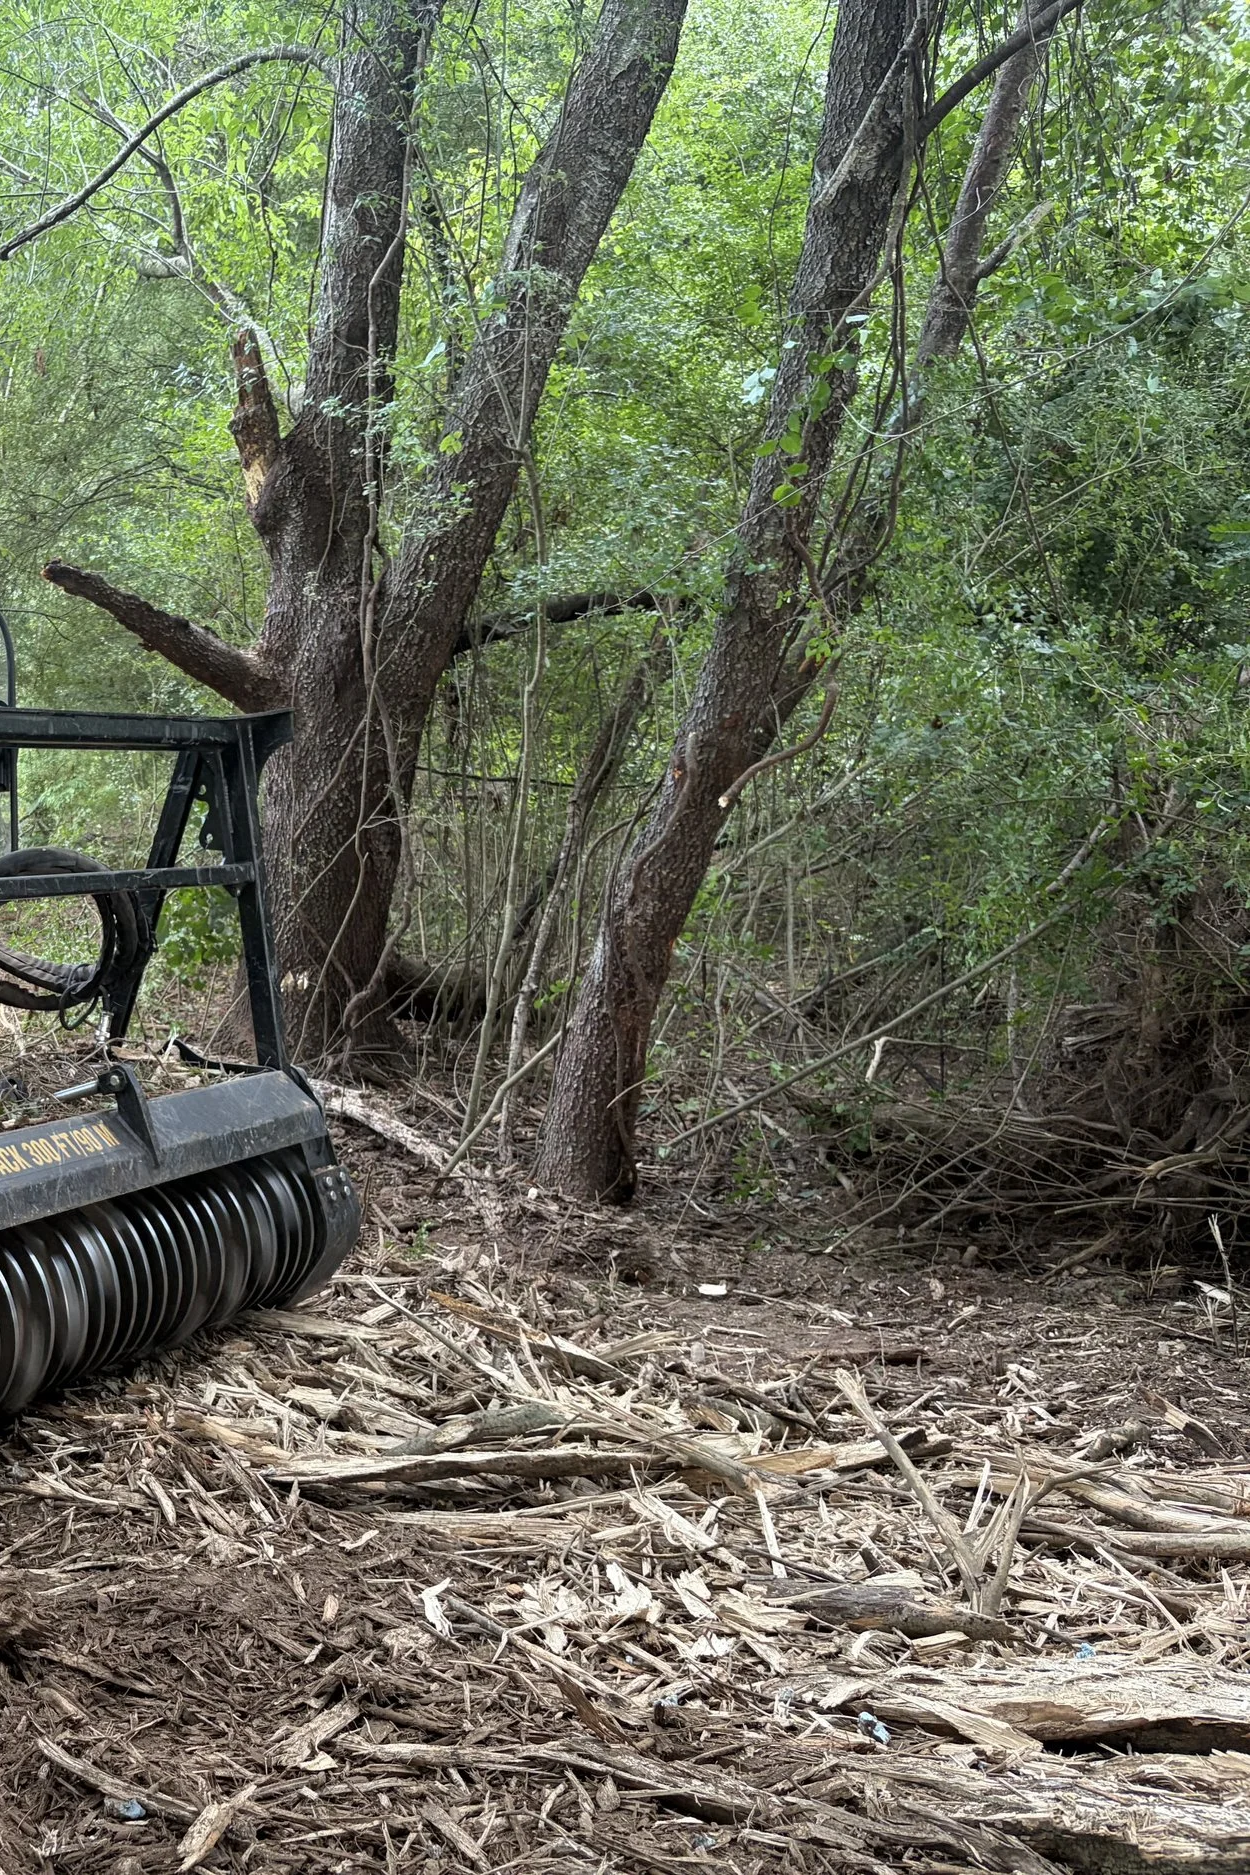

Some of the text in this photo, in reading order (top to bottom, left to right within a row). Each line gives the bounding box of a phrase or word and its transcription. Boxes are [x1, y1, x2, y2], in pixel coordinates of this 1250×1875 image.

[21, 1137, 61, 1167] 300
[50, 1124, 103, 1158] FT/90
[93, 1119, 121, 1149] M
